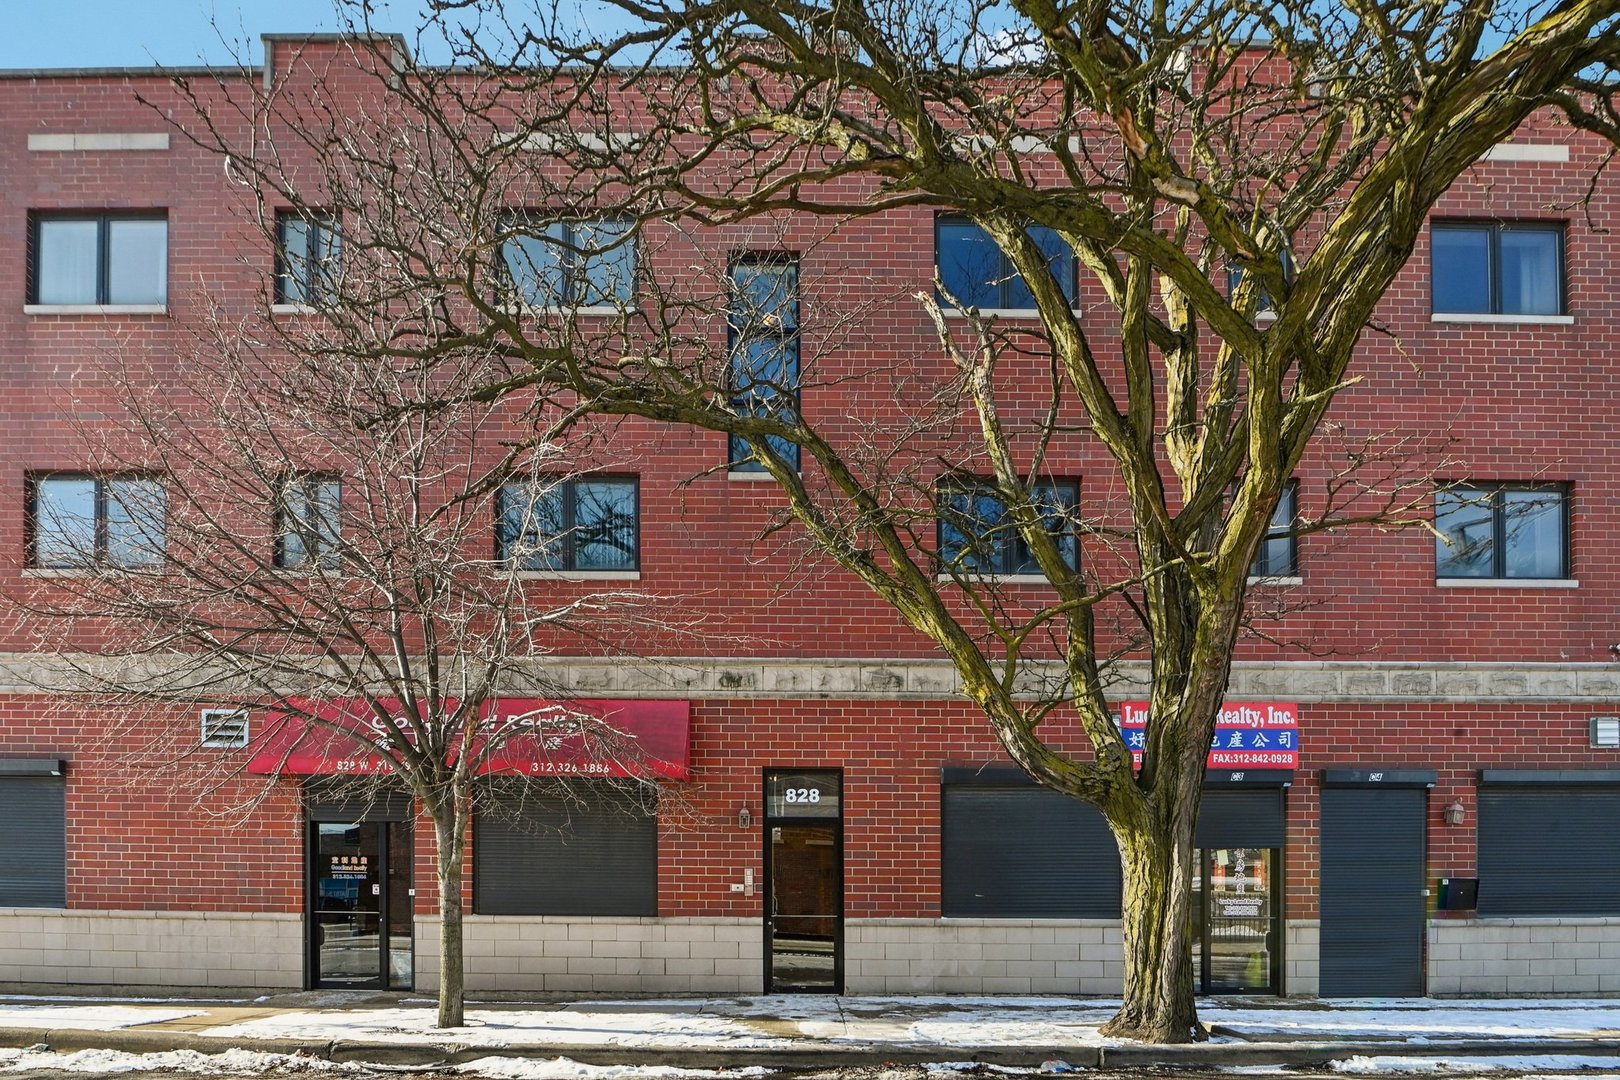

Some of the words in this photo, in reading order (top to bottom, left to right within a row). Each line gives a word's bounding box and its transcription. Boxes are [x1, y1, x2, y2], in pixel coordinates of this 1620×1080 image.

[1267, 706, 1295, 724] Inc.
[1213, 753, 1293, 764] FAX:312-842-0928
[785, 788, 820, 803] 828
